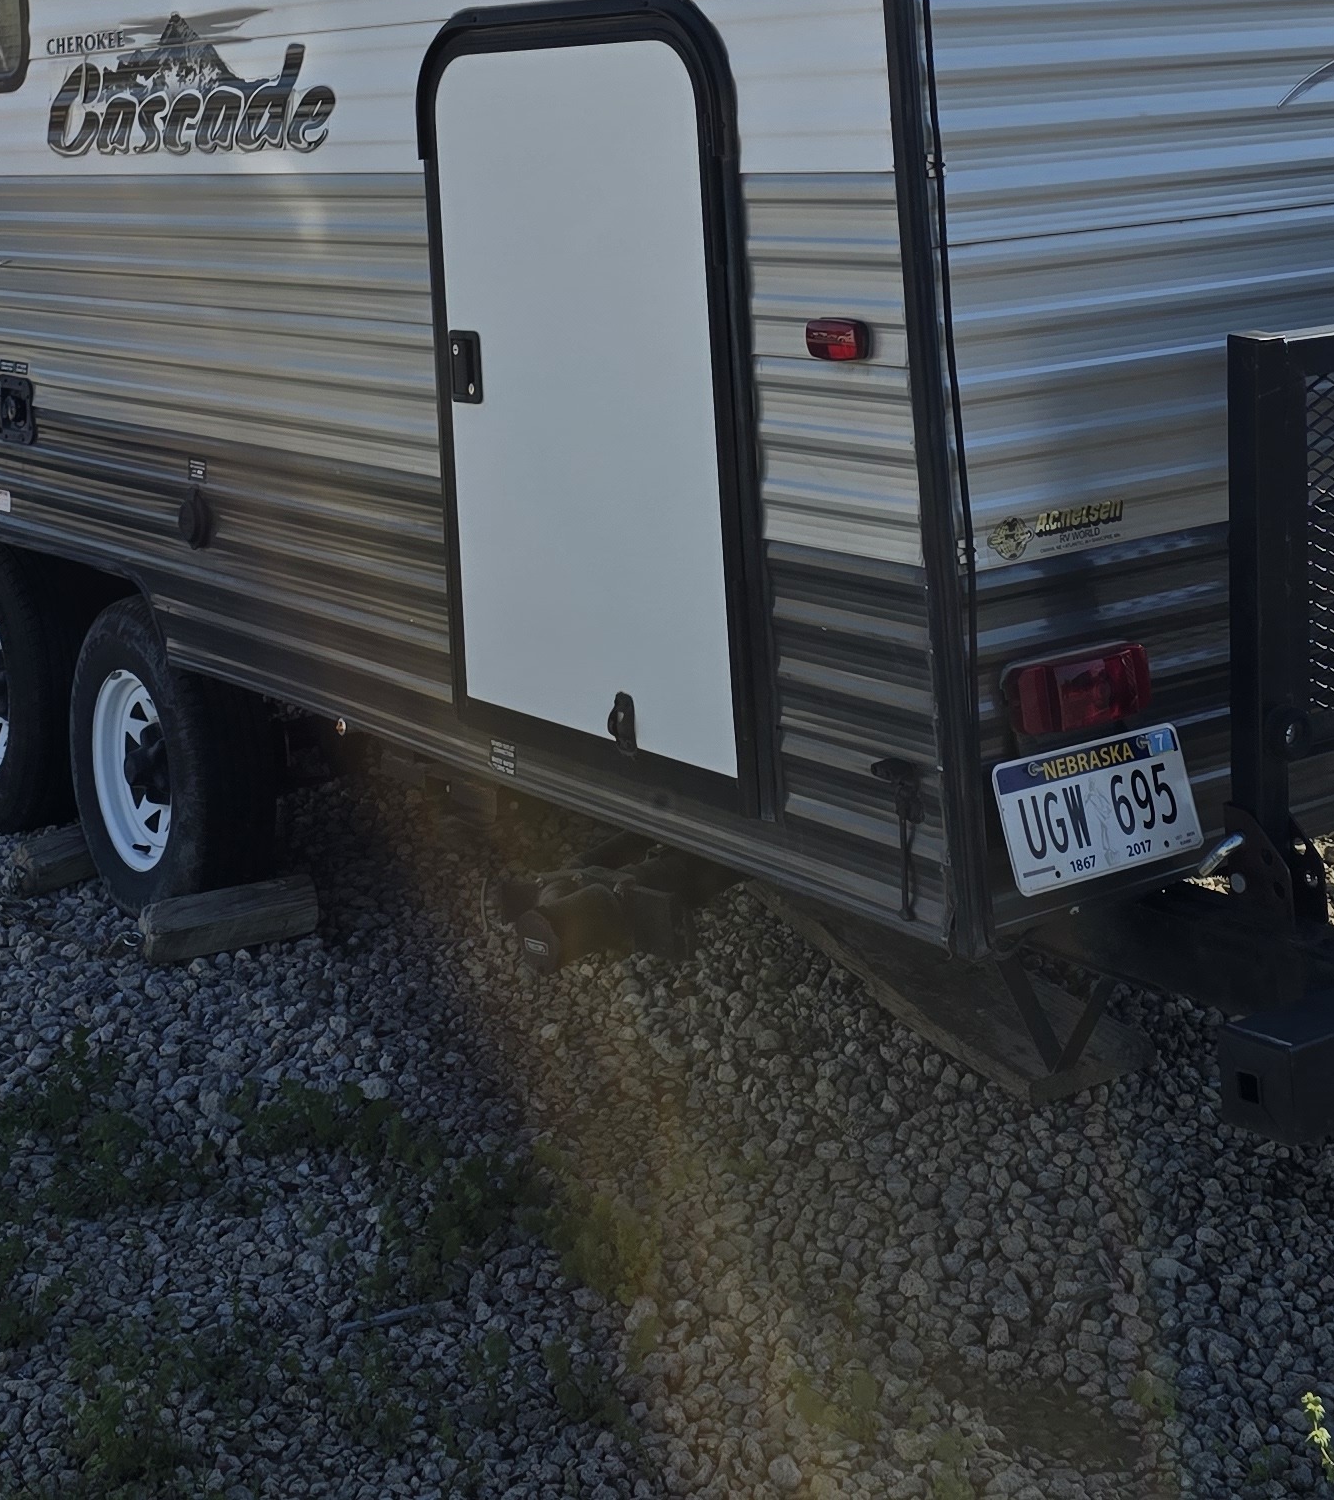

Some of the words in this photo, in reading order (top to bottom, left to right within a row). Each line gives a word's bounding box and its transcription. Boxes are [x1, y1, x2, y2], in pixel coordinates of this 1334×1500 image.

[46, 30, 125, 56] CHEROKEE
[48, 44, 336, 156] Cascade
[1042, 742, 1135, 781] NEBRASKA
[1154, 734, 1164, 751] 7
[1017, 784, 1092, 860] UGW
[1110, 762, 1178, 836] 695
[1069, 855, 1096, 873] 1867
[1126, 840, 1152, 857] 2017
